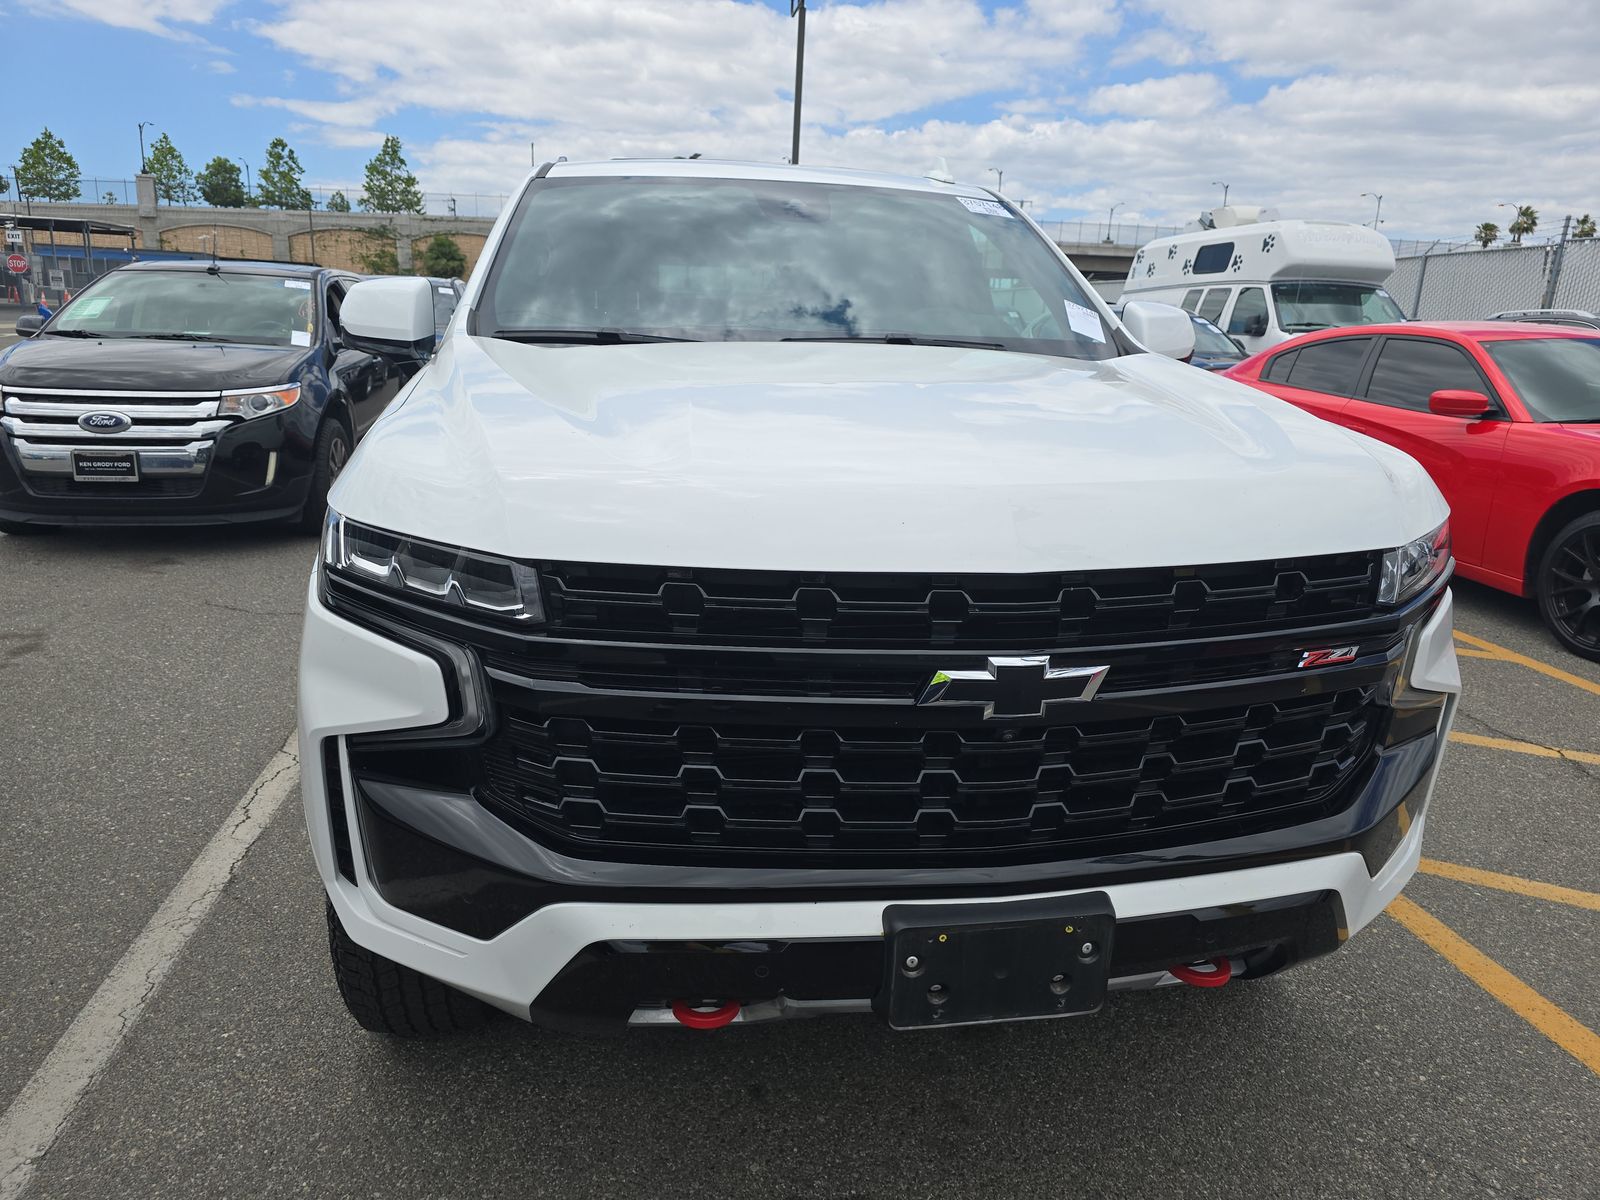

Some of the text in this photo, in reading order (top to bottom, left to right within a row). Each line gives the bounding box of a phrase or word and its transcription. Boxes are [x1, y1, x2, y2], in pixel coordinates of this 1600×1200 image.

[8, 259, 26, 268] STOP
[89, 415, 116, 426] Ford
[1297, 645, 1360, 668] Z71
